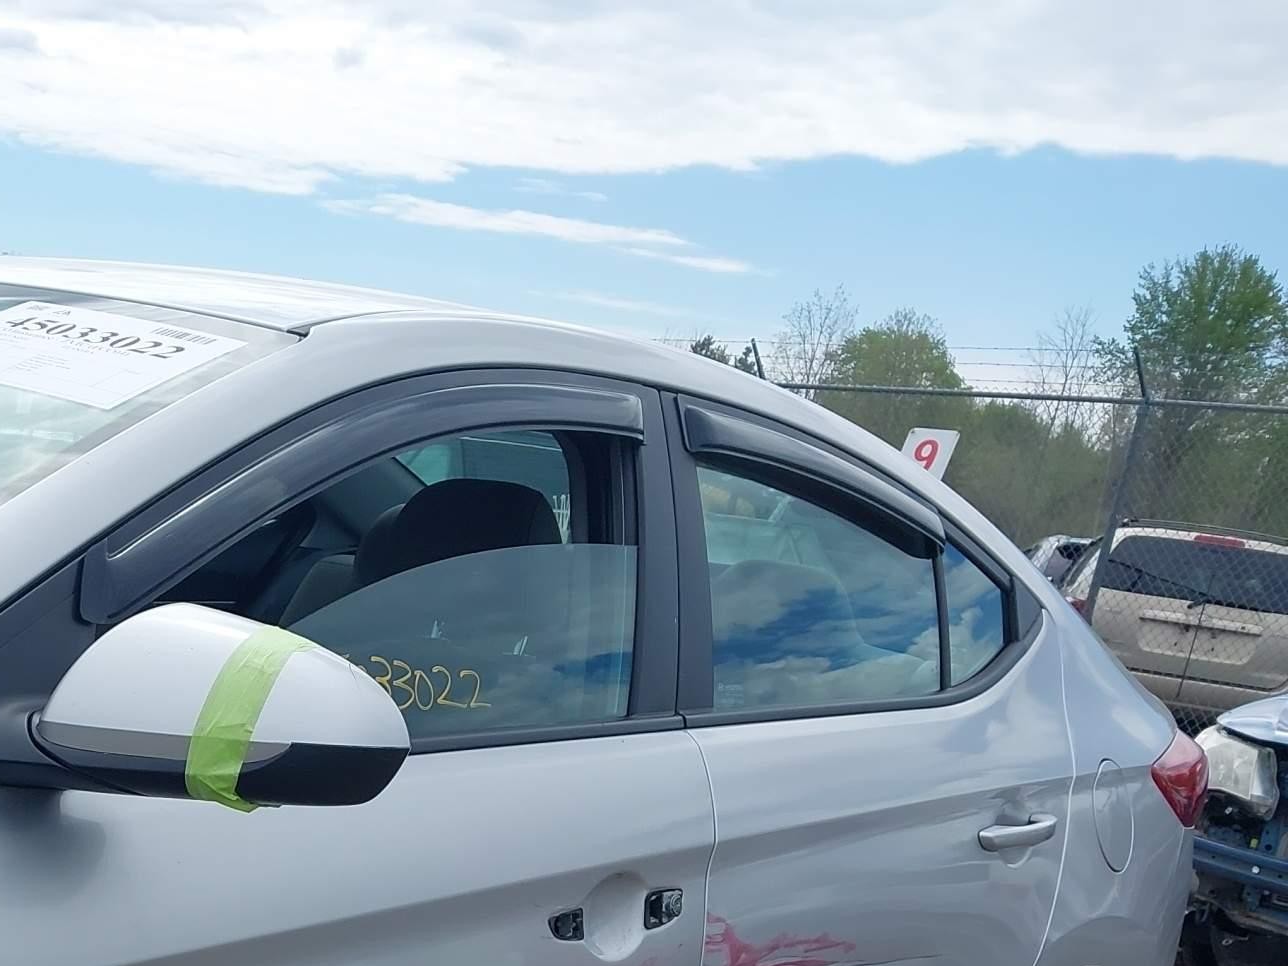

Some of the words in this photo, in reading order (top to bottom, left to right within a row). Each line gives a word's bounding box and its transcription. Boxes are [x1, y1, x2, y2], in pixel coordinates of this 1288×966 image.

[6, 316, 185, 358] 45033022
[914, 439, 939, 471] 9
[344, 654, 491, 711] 33022
